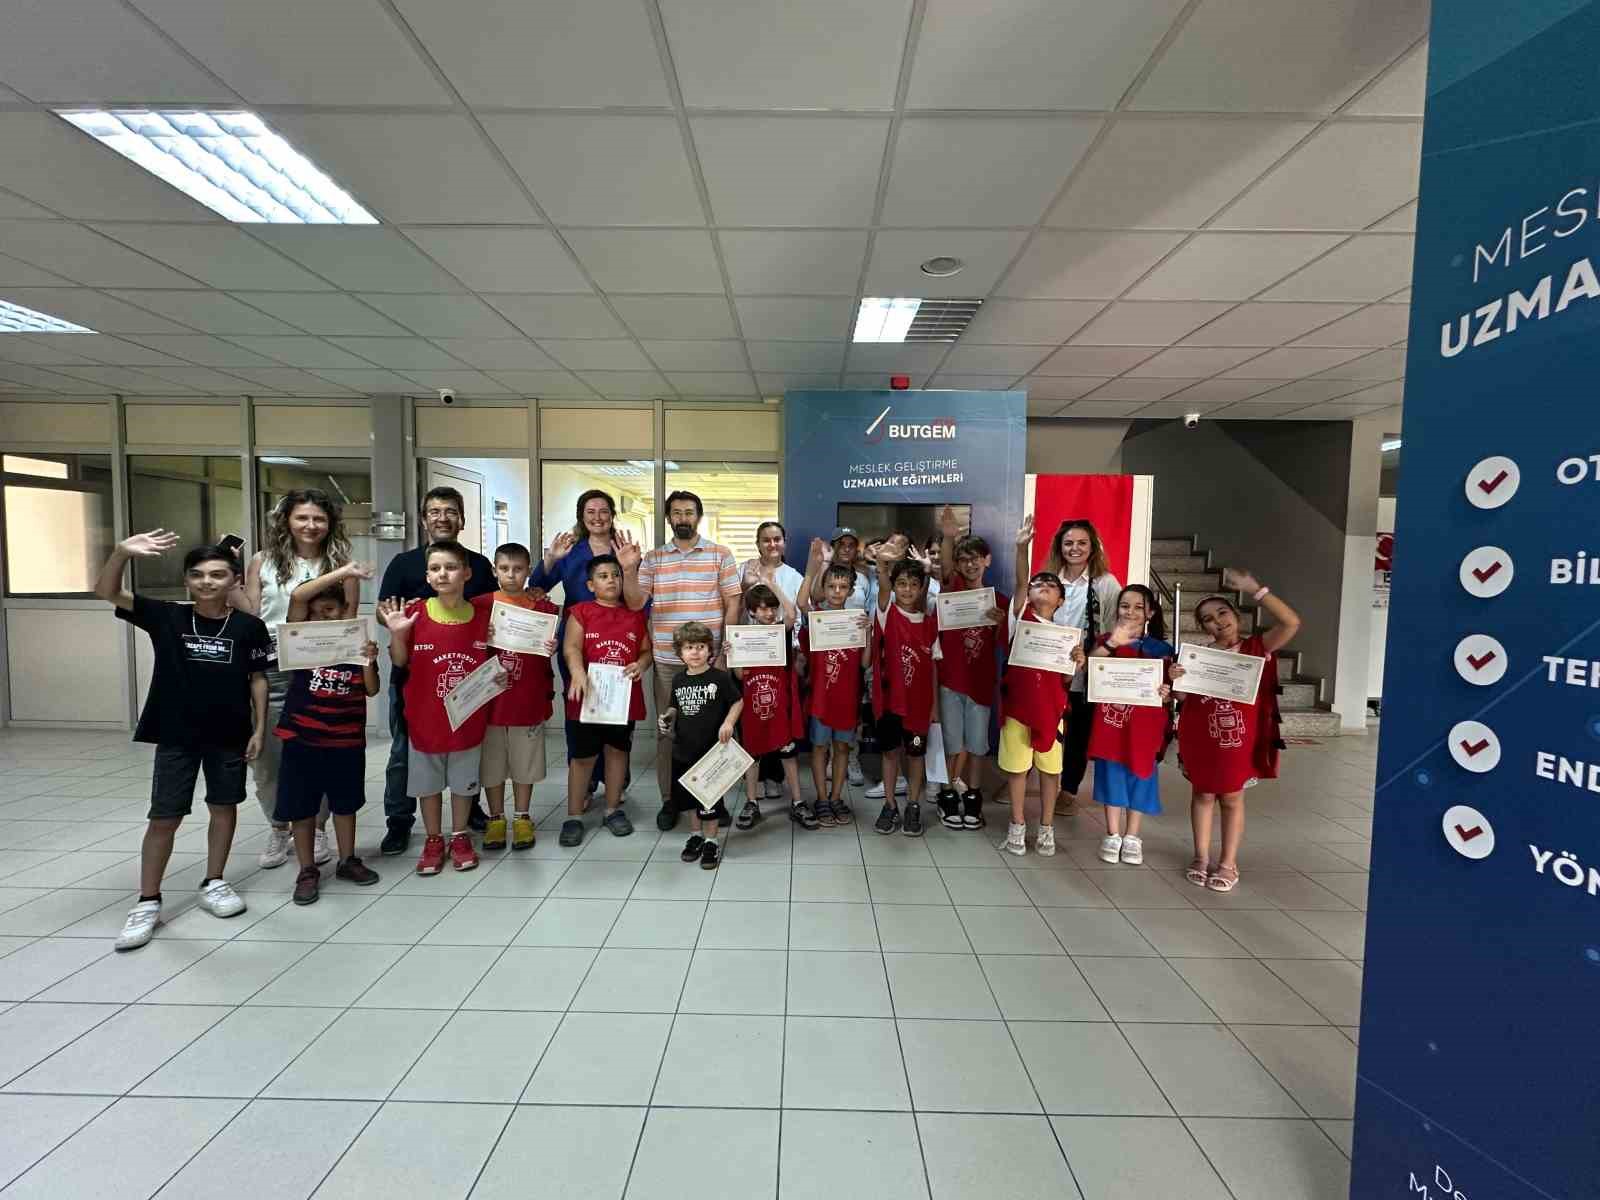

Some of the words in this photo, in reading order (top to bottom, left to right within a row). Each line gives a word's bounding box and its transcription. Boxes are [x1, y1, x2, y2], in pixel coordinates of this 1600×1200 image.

[1473, 187, 1600, 283] MES
[888, 424, 956, 438] BUTGEM
[849, 463, 891, 475] MESLEK
[894, 459, 958, 473] GELİŞTİRME
[843, 477, 899, 489] UZMANLIK
[902, 472, 964, 486] EĞİTİMLERİ
[414, 643, 434, 651] BTSO
